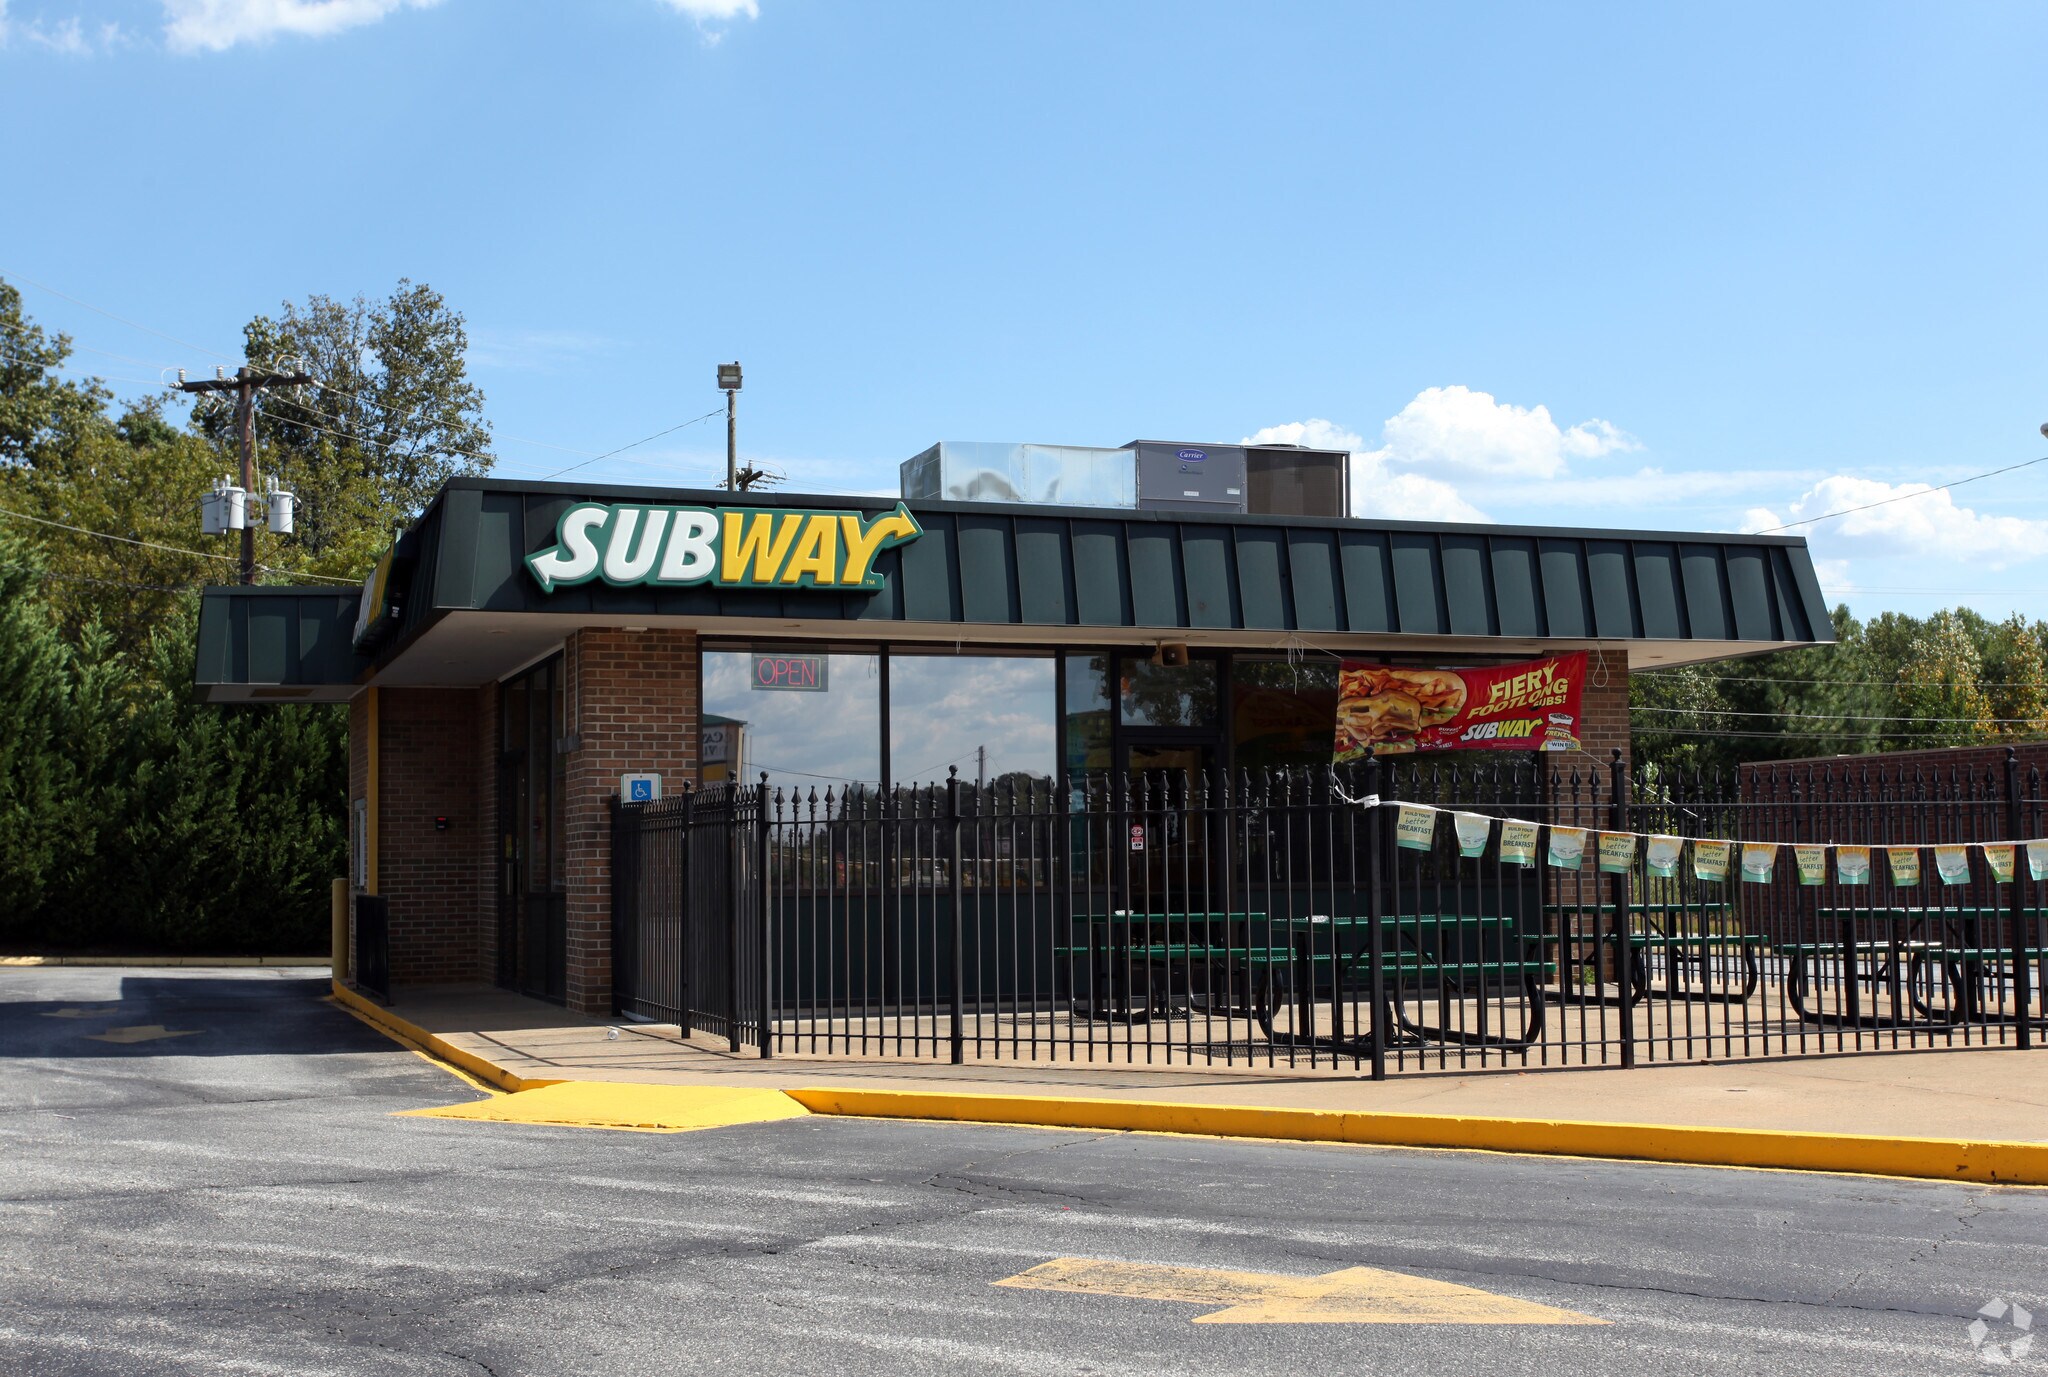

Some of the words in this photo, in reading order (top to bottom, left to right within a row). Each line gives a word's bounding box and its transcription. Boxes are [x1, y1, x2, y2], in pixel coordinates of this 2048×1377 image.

[1179, 451, 1204, 460] Carrier
[531, 508, 917, 586] SUBWAY
[758, 657, 816, 686] OPEN
[1489, 662, 1559, 704] FIERY
[1467, 678, 1569, 720] FOOTLONG
[1460, 718, 1544, 742] SUBWAY
[1544, 730, 1571, 739] FRENZY
[1405, 816, 1428, 825] better
[1397, 824, 1432, 835] BREAKFAST
[1503, 840, 1534, 848] BREAKFAST
[1599, 849, 1633, 859] BREAKFAST
[1702, 850, 1722, 858] better
[1696, 857, 1727, 867] BREAKFAST
